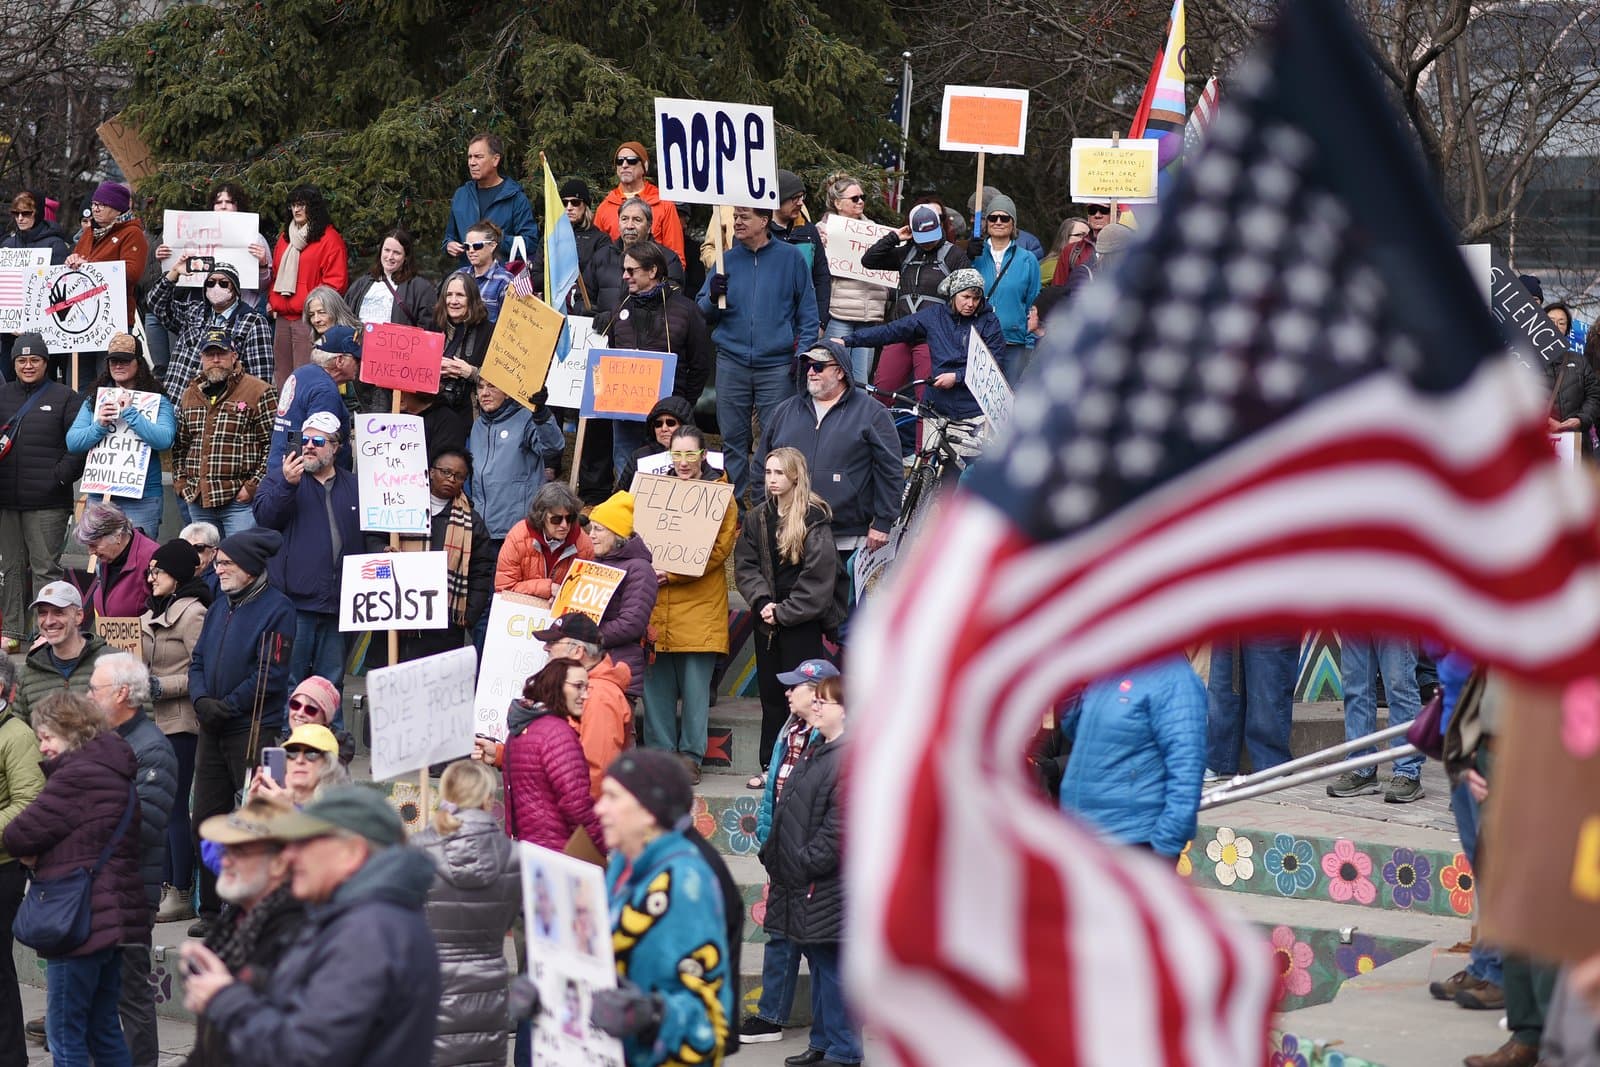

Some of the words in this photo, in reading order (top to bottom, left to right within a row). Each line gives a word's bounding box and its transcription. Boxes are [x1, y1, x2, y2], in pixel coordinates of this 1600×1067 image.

[661, 111, 776, 199] nope.
[15, 259, 31, 267] LAW
[25, 273, 38, 316] RIGHTS
[375, 331, 421, 354] STOP
[390, 350, 410, 361] THIS
[603, 383, 656, 398] AFRAID
[367, 418, 418, 439] Congress
[361, 440, 392, 457] GET
[400, 441, 420, 451] OFF
[90, 452, 117, 466] NOT
[123, 453, 136, 468] A
[83, 468, 145, 486] PRIVILEGE
[383, 492, 406, 506] He's
[634, 477, 731, 522] FELONS
[656, 512, 682, 532] BE
[584, 563, 622, 581] DEMOCRACY
[352, 580, 439, 625] RESIST
[571, 580, 611, 608] LOVE
[100, 622, 140, 640] OBEDIENCE
[374, 696, 414, 732] DUE
[376, 727, 415, 768] RULE
